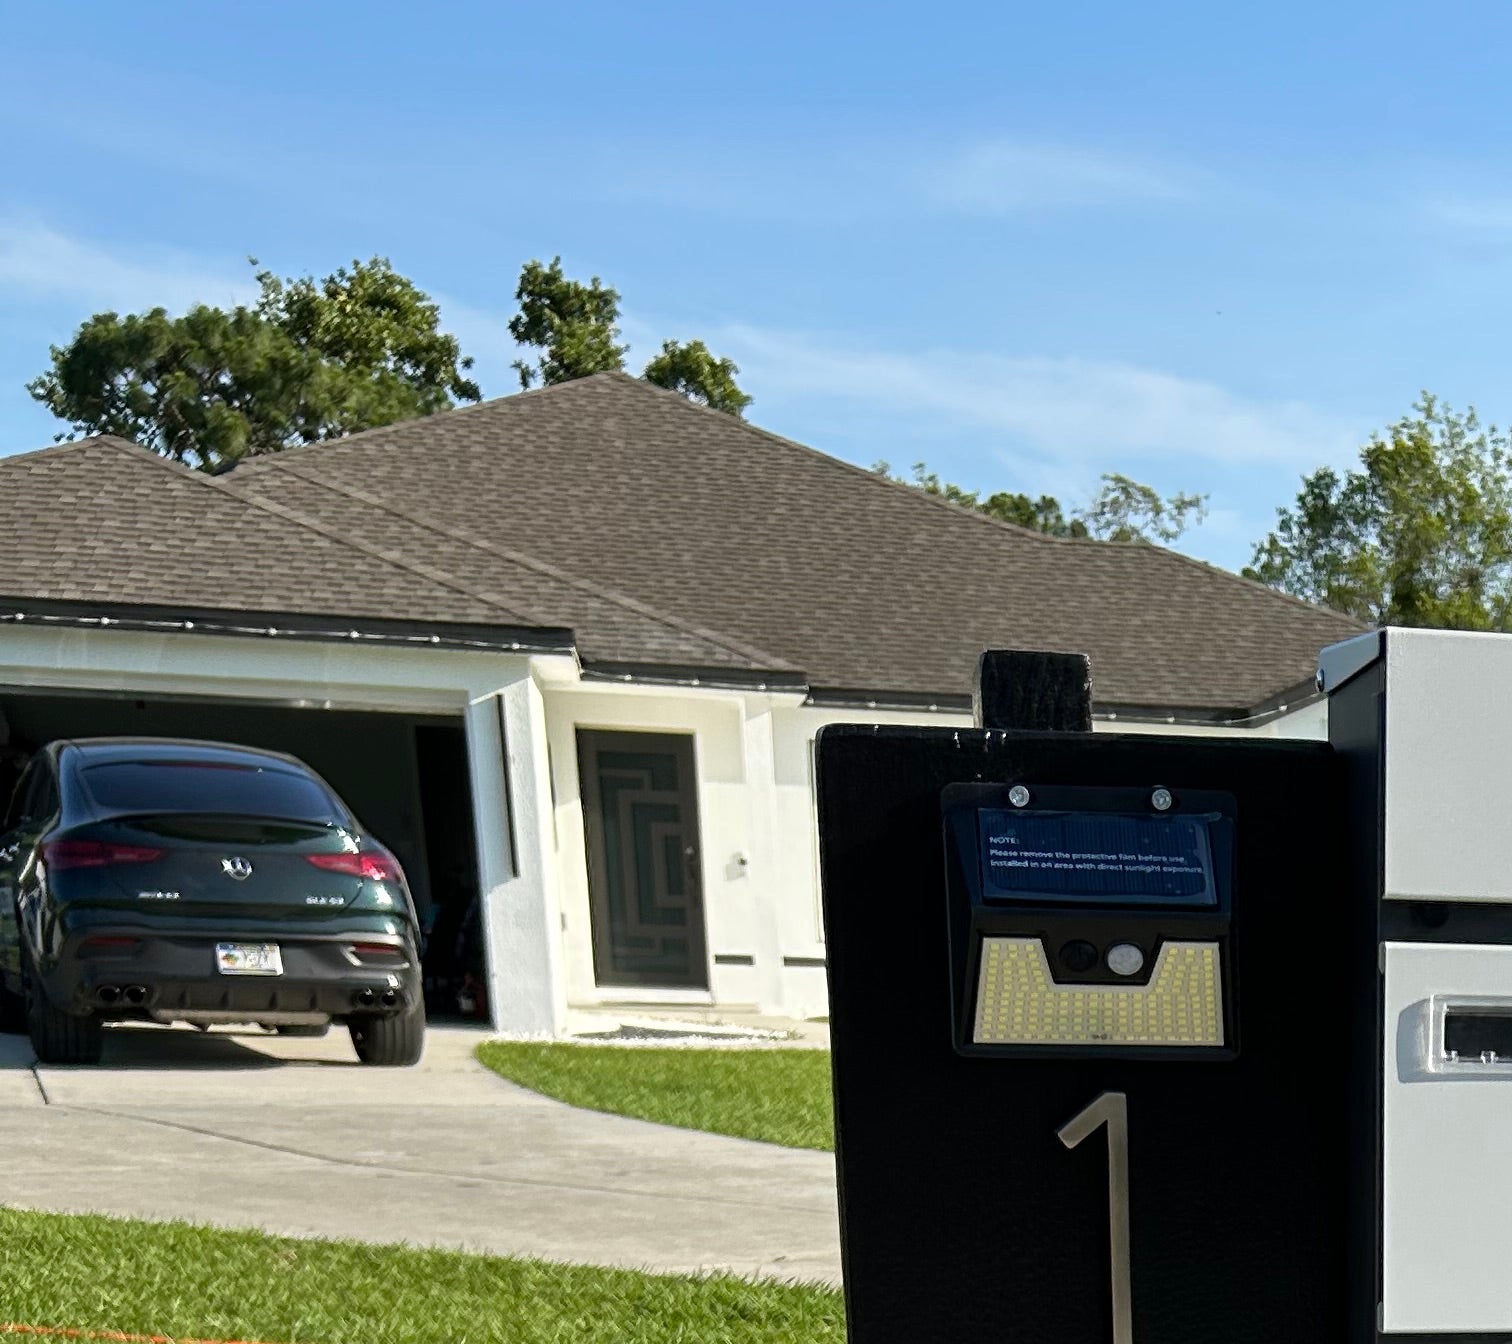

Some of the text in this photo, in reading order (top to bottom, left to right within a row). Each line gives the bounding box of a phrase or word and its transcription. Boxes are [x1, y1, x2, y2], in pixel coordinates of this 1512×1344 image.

[989, 849, 1018, 857] Please
[1020, 851, 1053, 859] remove
[1072, 853, 1118, 861] protective
[1119, 853, 1137, 861] film
[1138, 854, 1168, 862] before
[1097, 863, 1123, 872] direct
[1124, 865, 1161, 873] sunlight
